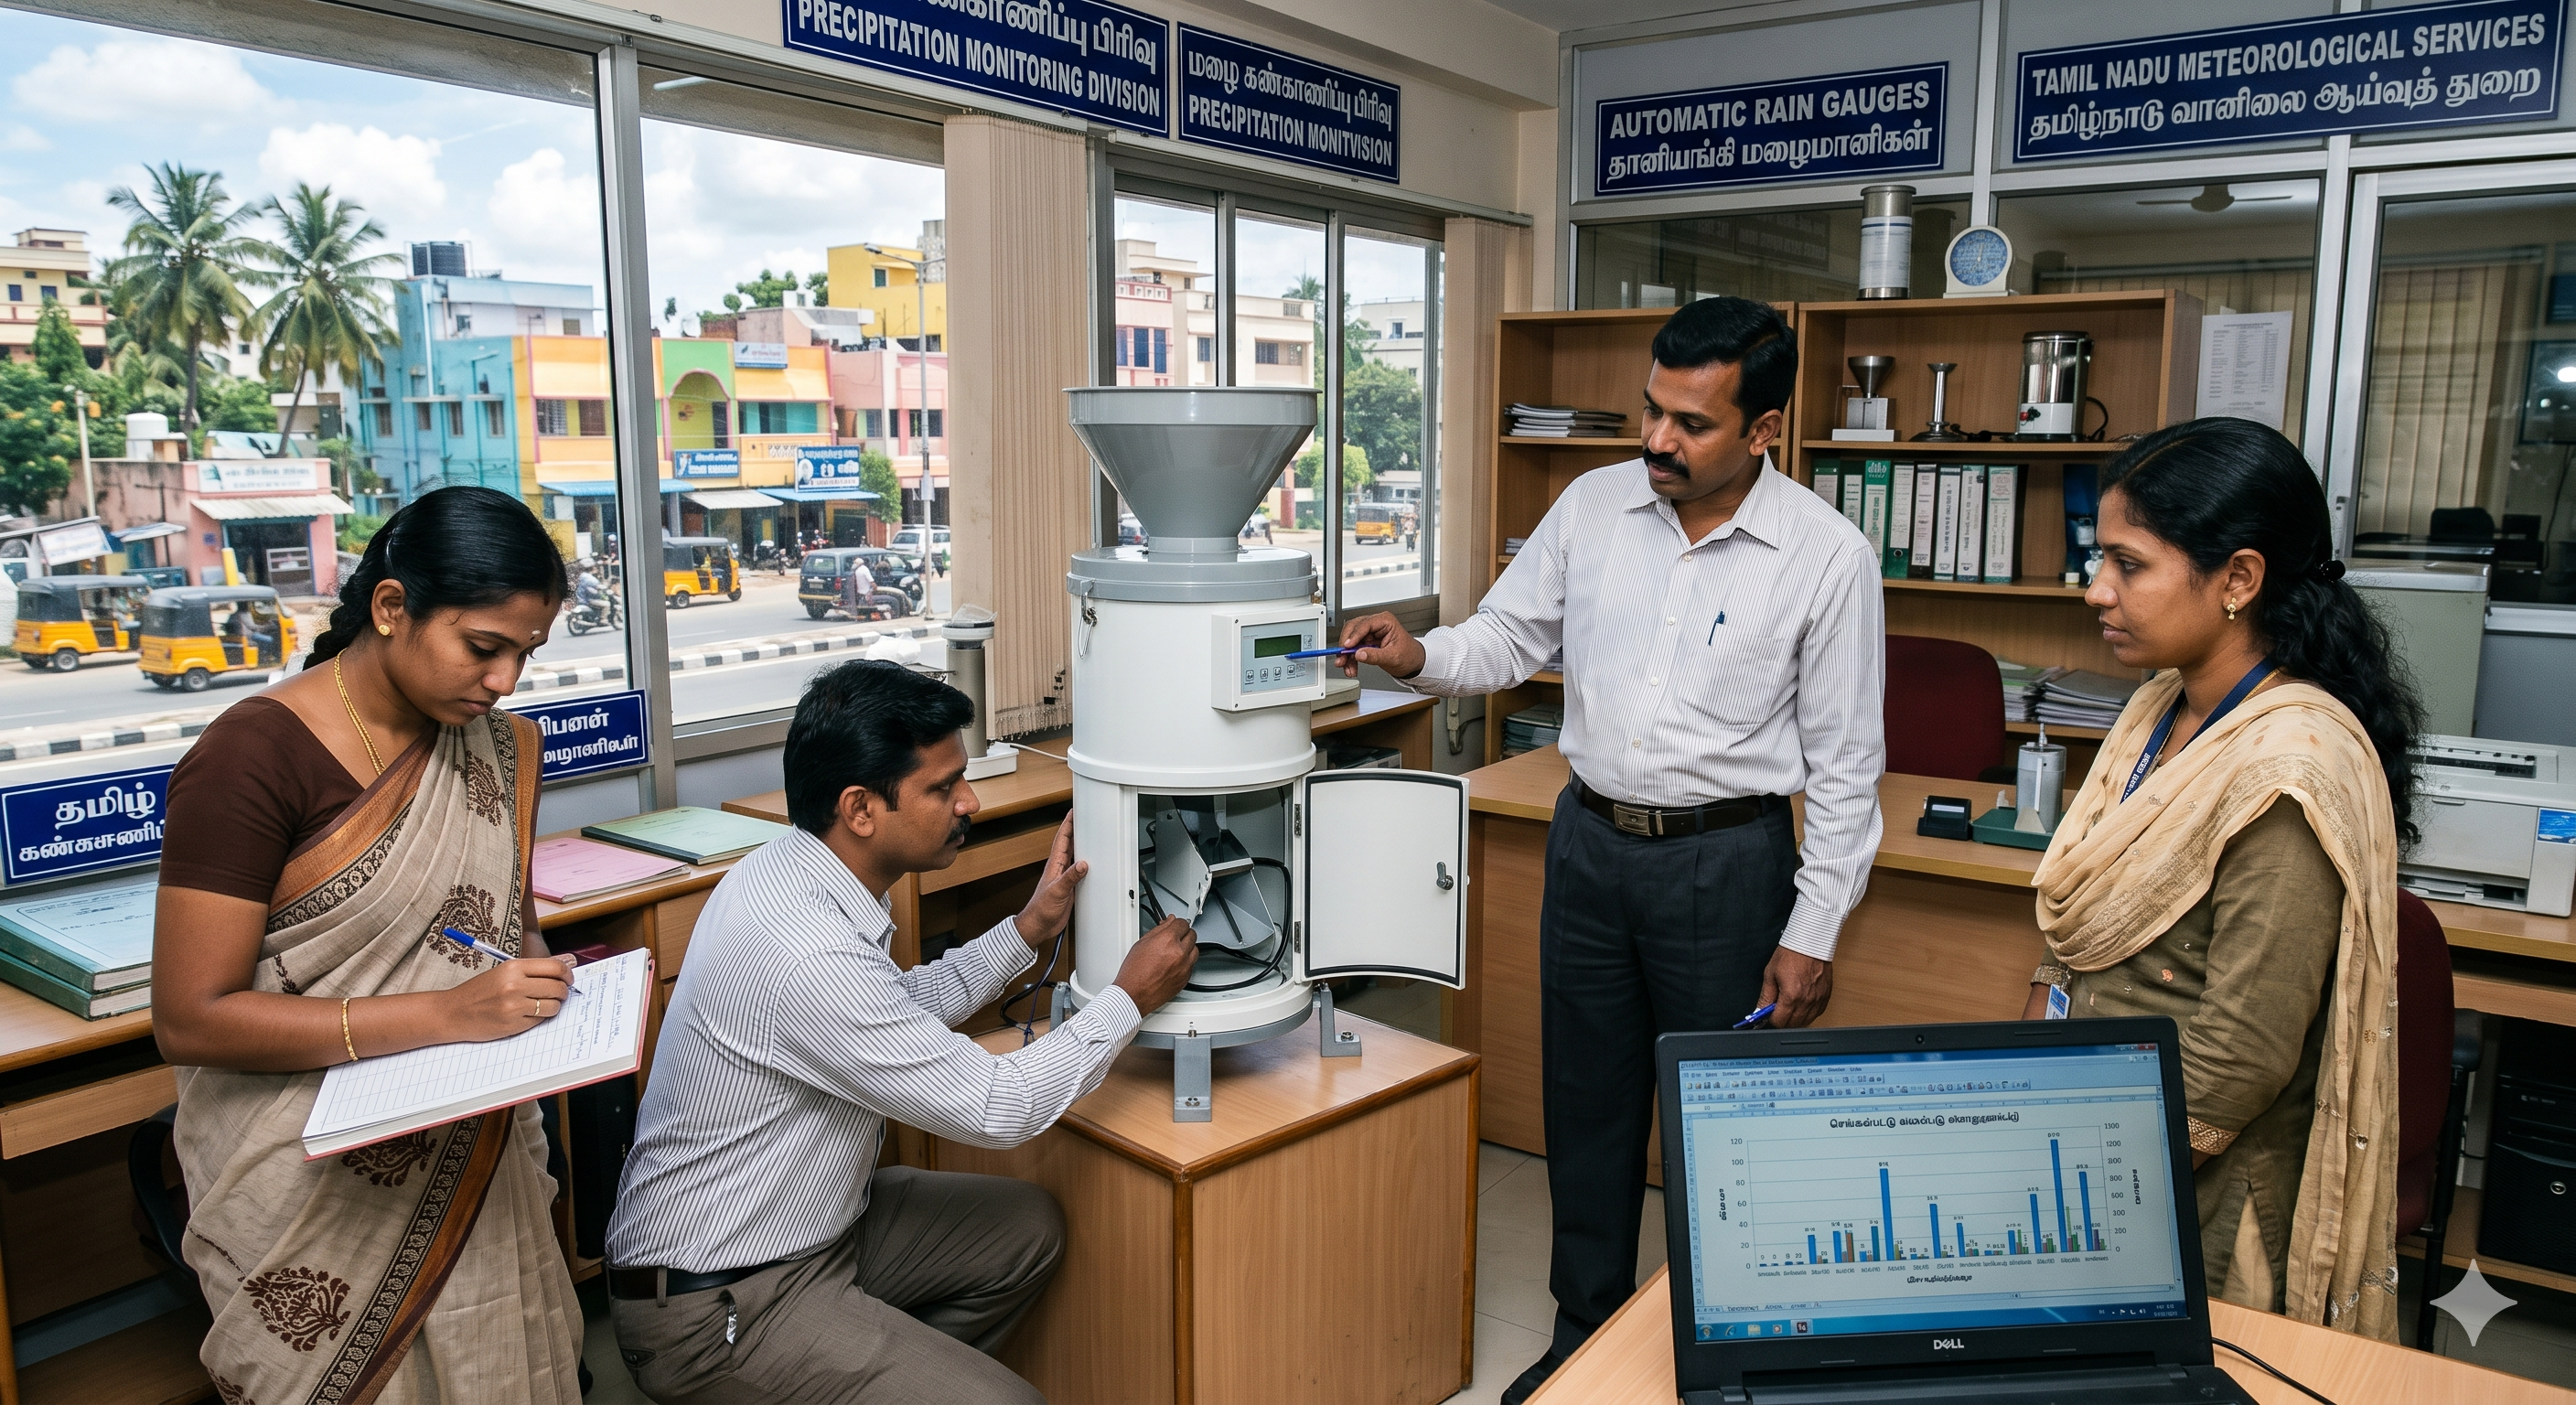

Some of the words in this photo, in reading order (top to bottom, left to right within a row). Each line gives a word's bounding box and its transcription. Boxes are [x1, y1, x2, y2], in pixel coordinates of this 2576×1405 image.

[798, 0, 960, 68] PRECIPITATION
[965, 37, 1083, 98] MONITORING
[1088, 70, 1160, 117] DIVISION
[1093, 16, 1156, 75] பிரிவு
[2032, 63, 2099, 97] TAMIL
[2106, 55, 2171, 90] NADU
[2177, 28, 2405, 82] METEOROLOGICAL
[2412, 13, 2545, 57] SERVICES
[1188, 50, 1240, 95] மழை
[1243, 60, 1351, 123] கண்காணிப்பு
[1354, 88, 1392, 133] பிரிவு
[1609, 100, 1747, 139] AUTOMATIC
[1755, 92, 1814, 125] RAIN
[1821, 80, 1930, 118] GAUGES
[2027, 99, 2164, 145] தமிழ்நாடு
[2171, 86, 2307, 124] வானிலை
[2313, 66, 2439, 114] ஆய்வுத்
[2444, 67, 2541, 108] துறை
[1188, 93, 1304, 147] PRECIPITATION
[1307, 122, 1392, 166] MONITVISION
[1605, 136, 1735, 185] தானியங்கி
[1742, 118, 1933, 170] மழைமானிகள்
[54, 781, 156, 831] தமிழ்
[1730, 1137, 1743, 1145] 120
[1731, 1158, 1744, 1166] 100
[2106, 1140, 2121, 1148] 1200
[1738, 1220, 1748, 1228] 40
[1740, 1241, 1750, 1249] 20
[2114, 1227, 2127, 1235] 200
[1933, 1338, 1965, 1350] DELL
